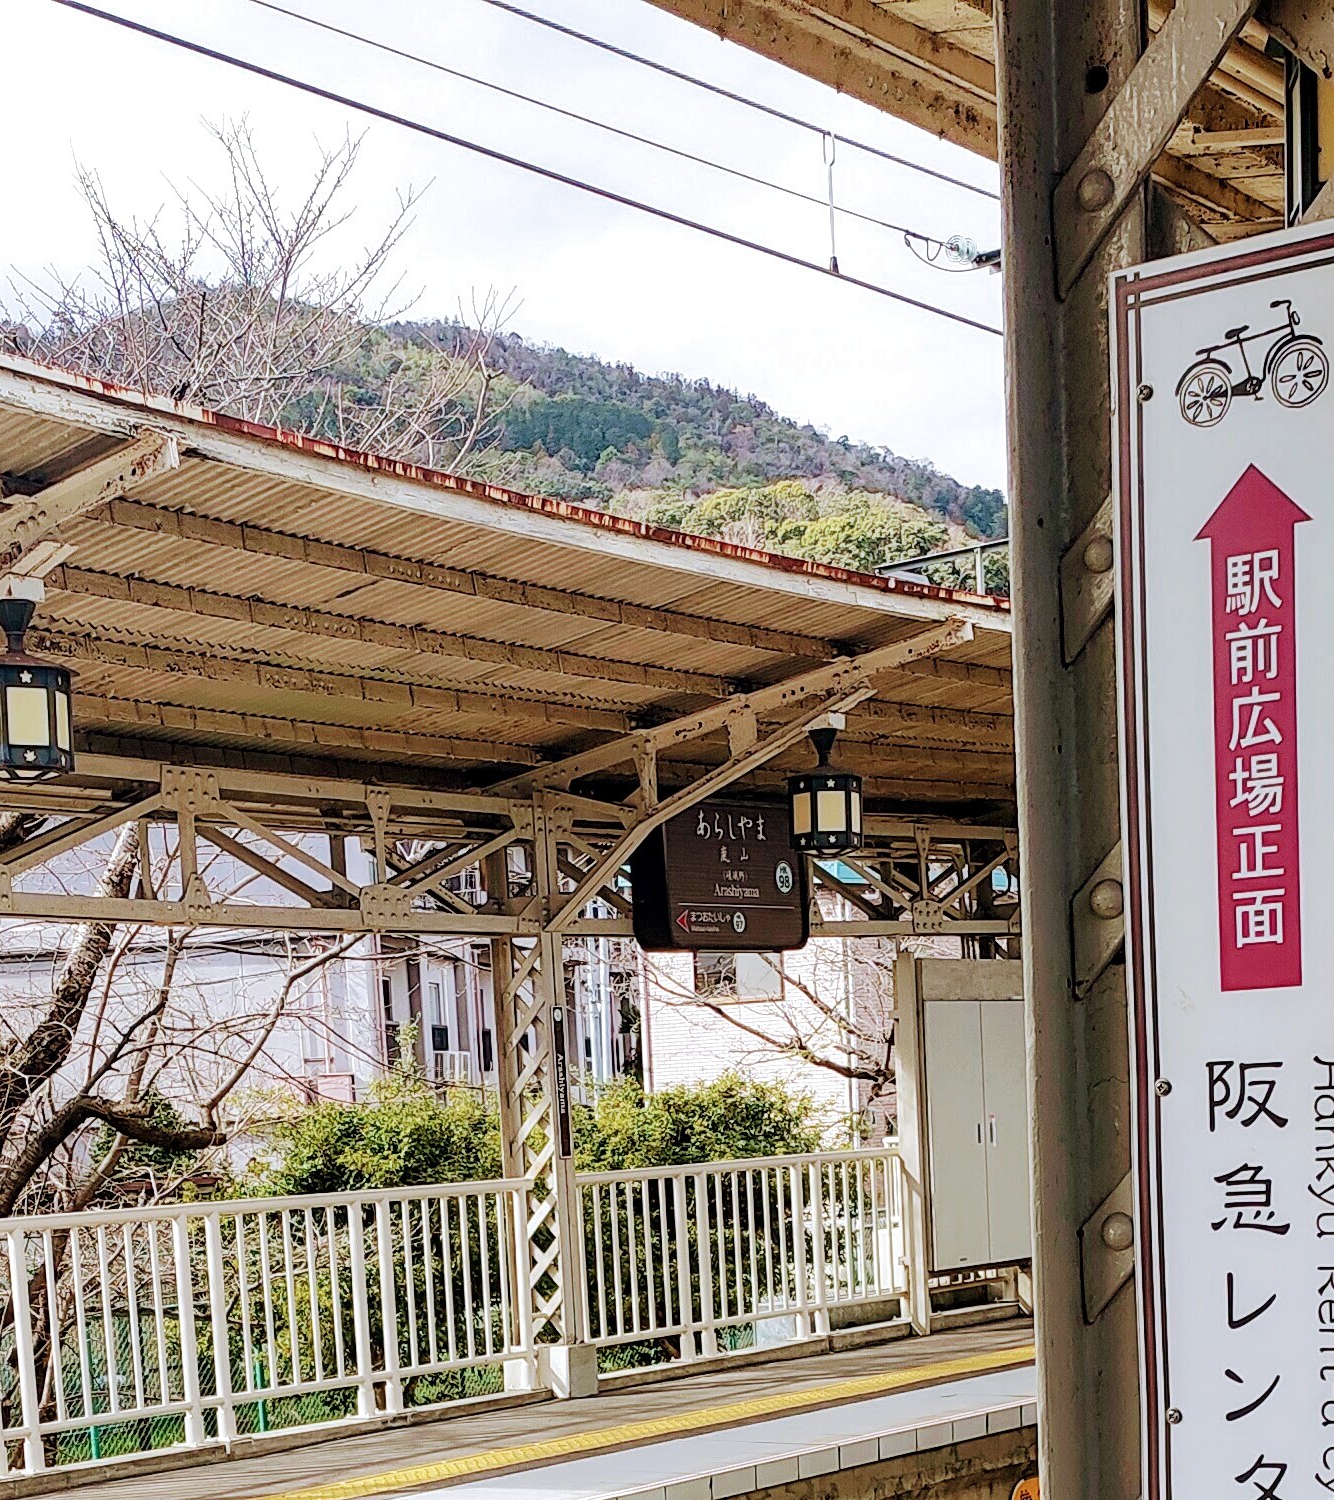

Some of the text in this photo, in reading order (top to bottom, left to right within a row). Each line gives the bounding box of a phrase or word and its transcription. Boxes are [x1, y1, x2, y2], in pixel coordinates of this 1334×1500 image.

[1225, 548, 1285, 950] 駅前広場正面
[696, 809, 767, 841] あらしやま
[714, 883, 759, 899] Arashiyama
[779, 875, 790, 889] 98
